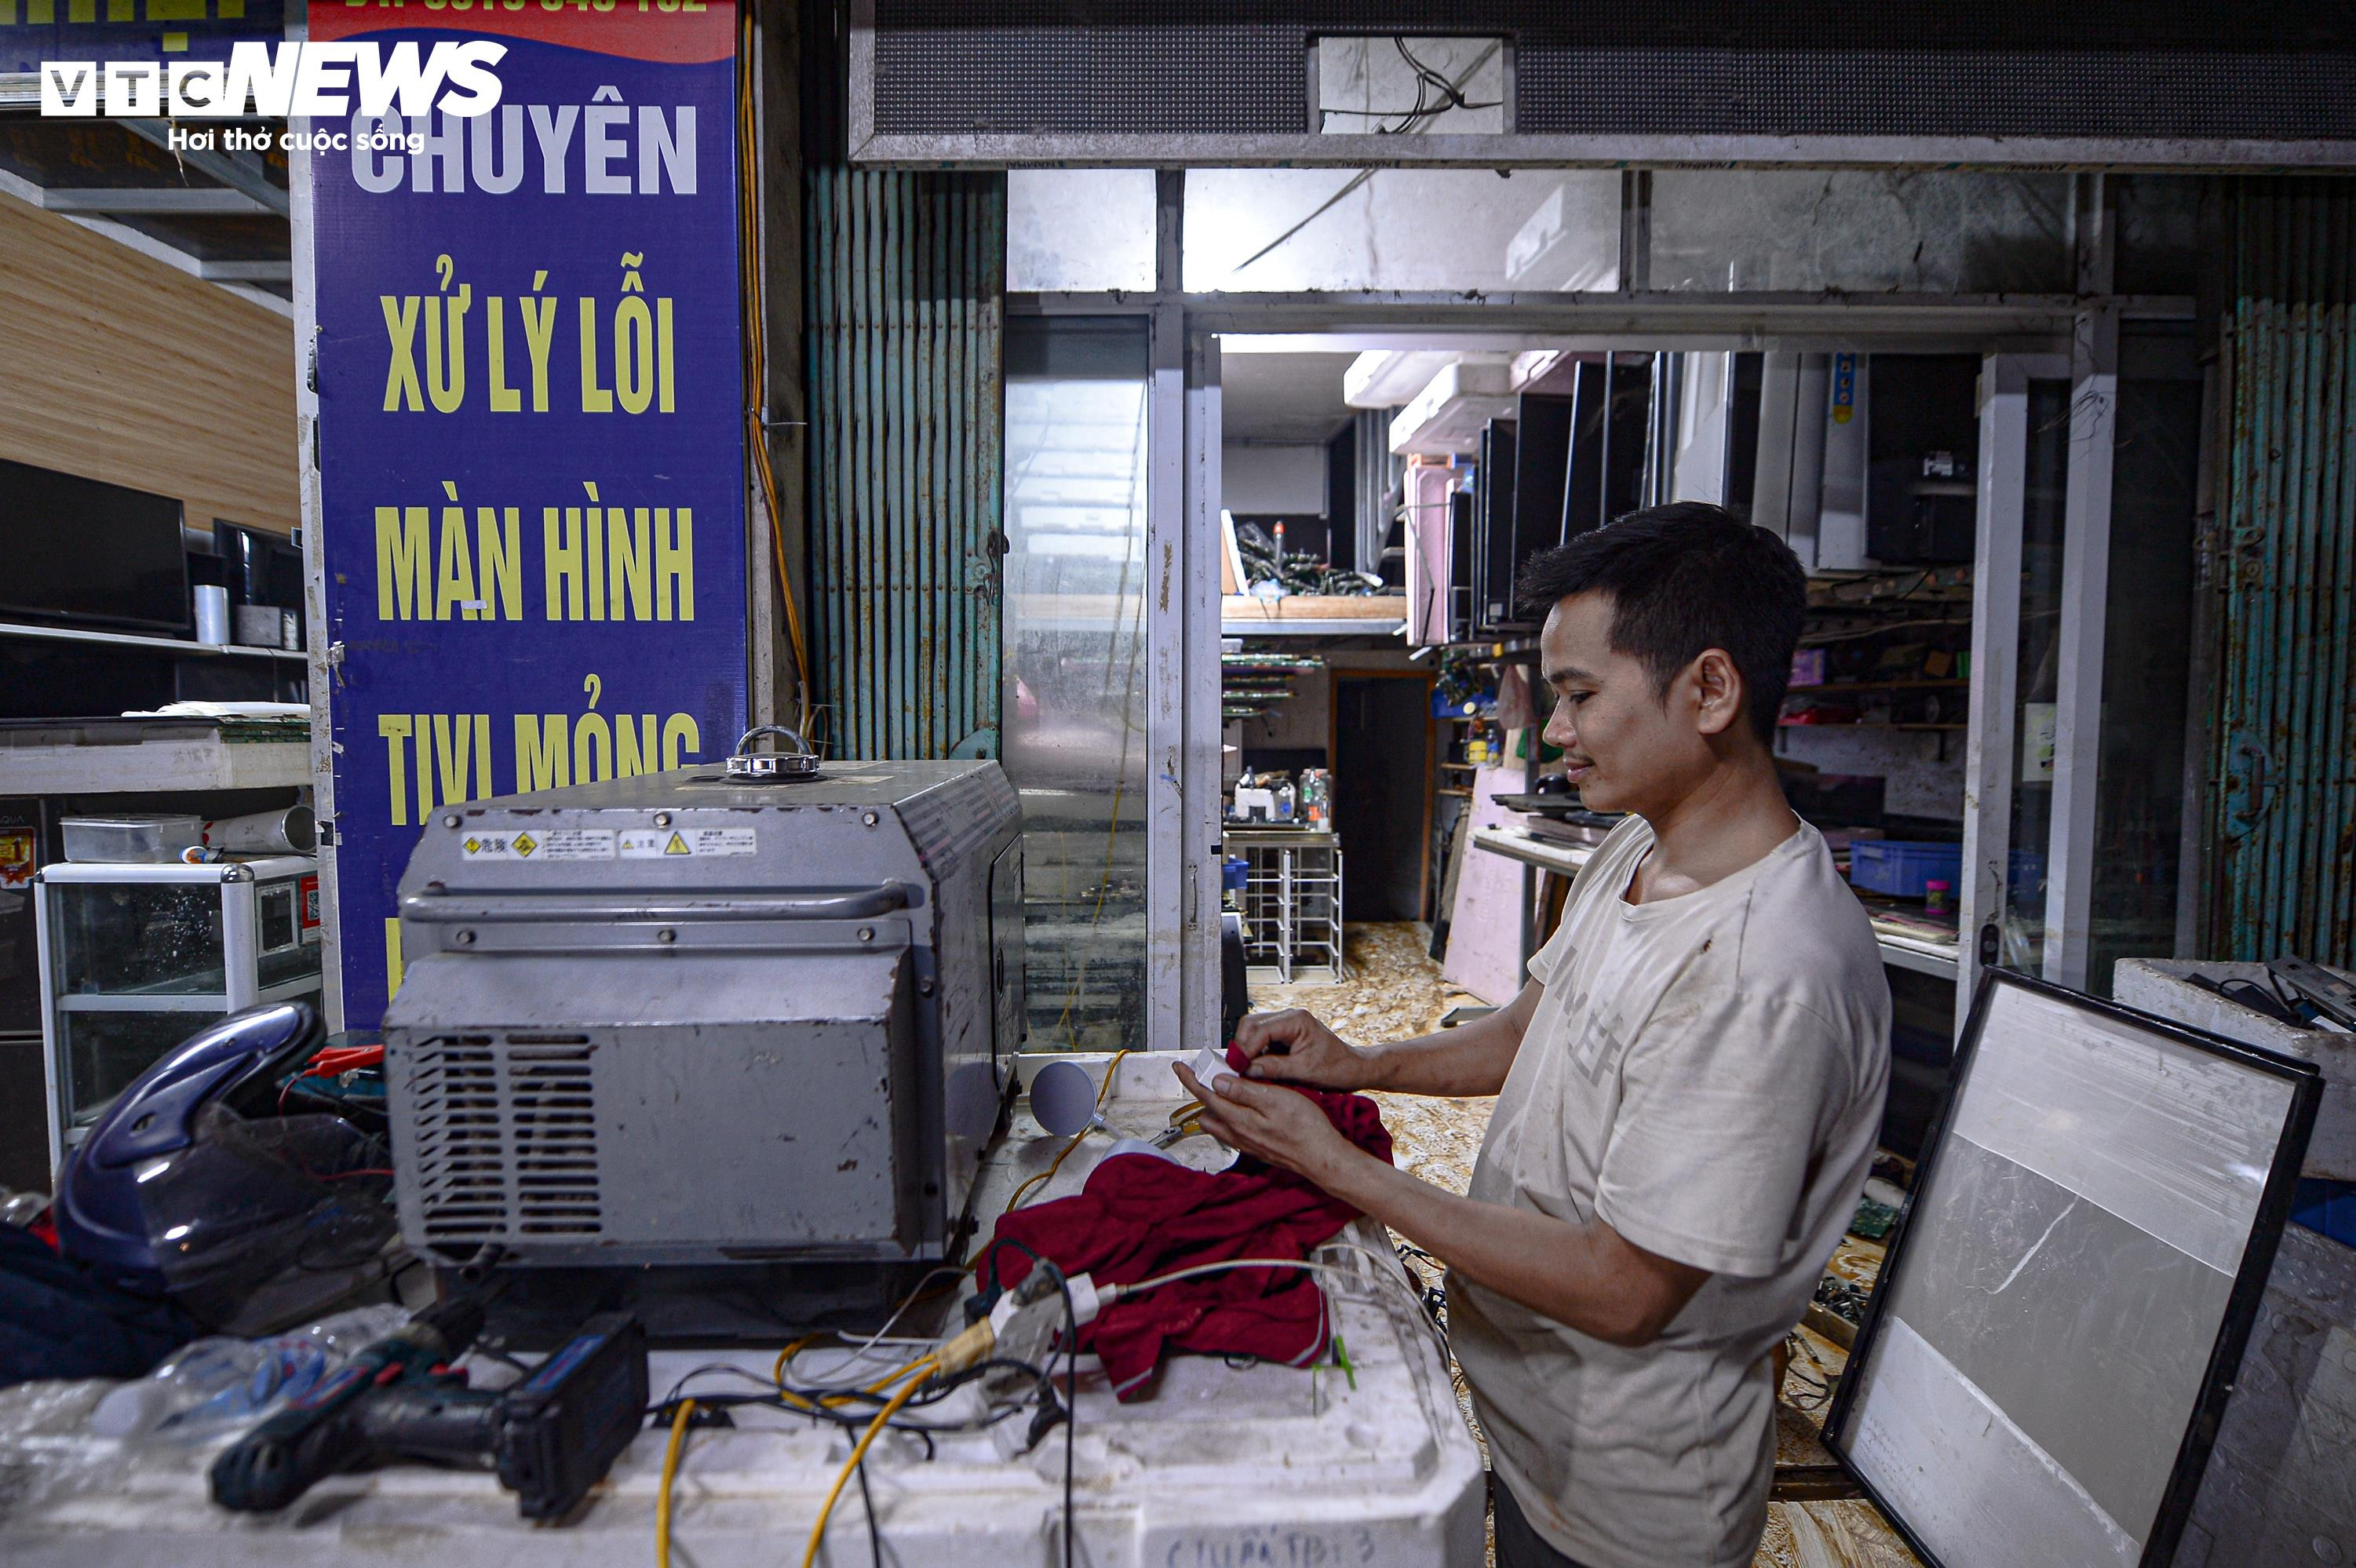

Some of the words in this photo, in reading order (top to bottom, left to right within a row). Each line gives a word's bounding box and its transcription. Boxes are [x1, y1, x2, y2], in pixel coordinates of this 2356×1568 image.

[351, 85, 697, 194] CHUYÊN
[380, 253, 471, 414] XỬ
[487, 270, 557, 413] LÝ
[579, 251, 675, 414] LỖI
[374, 480, 523, 621] MÀN
[543, 481, 695, 622] HÌNH
[377, 714, 492, 826] TIVI
